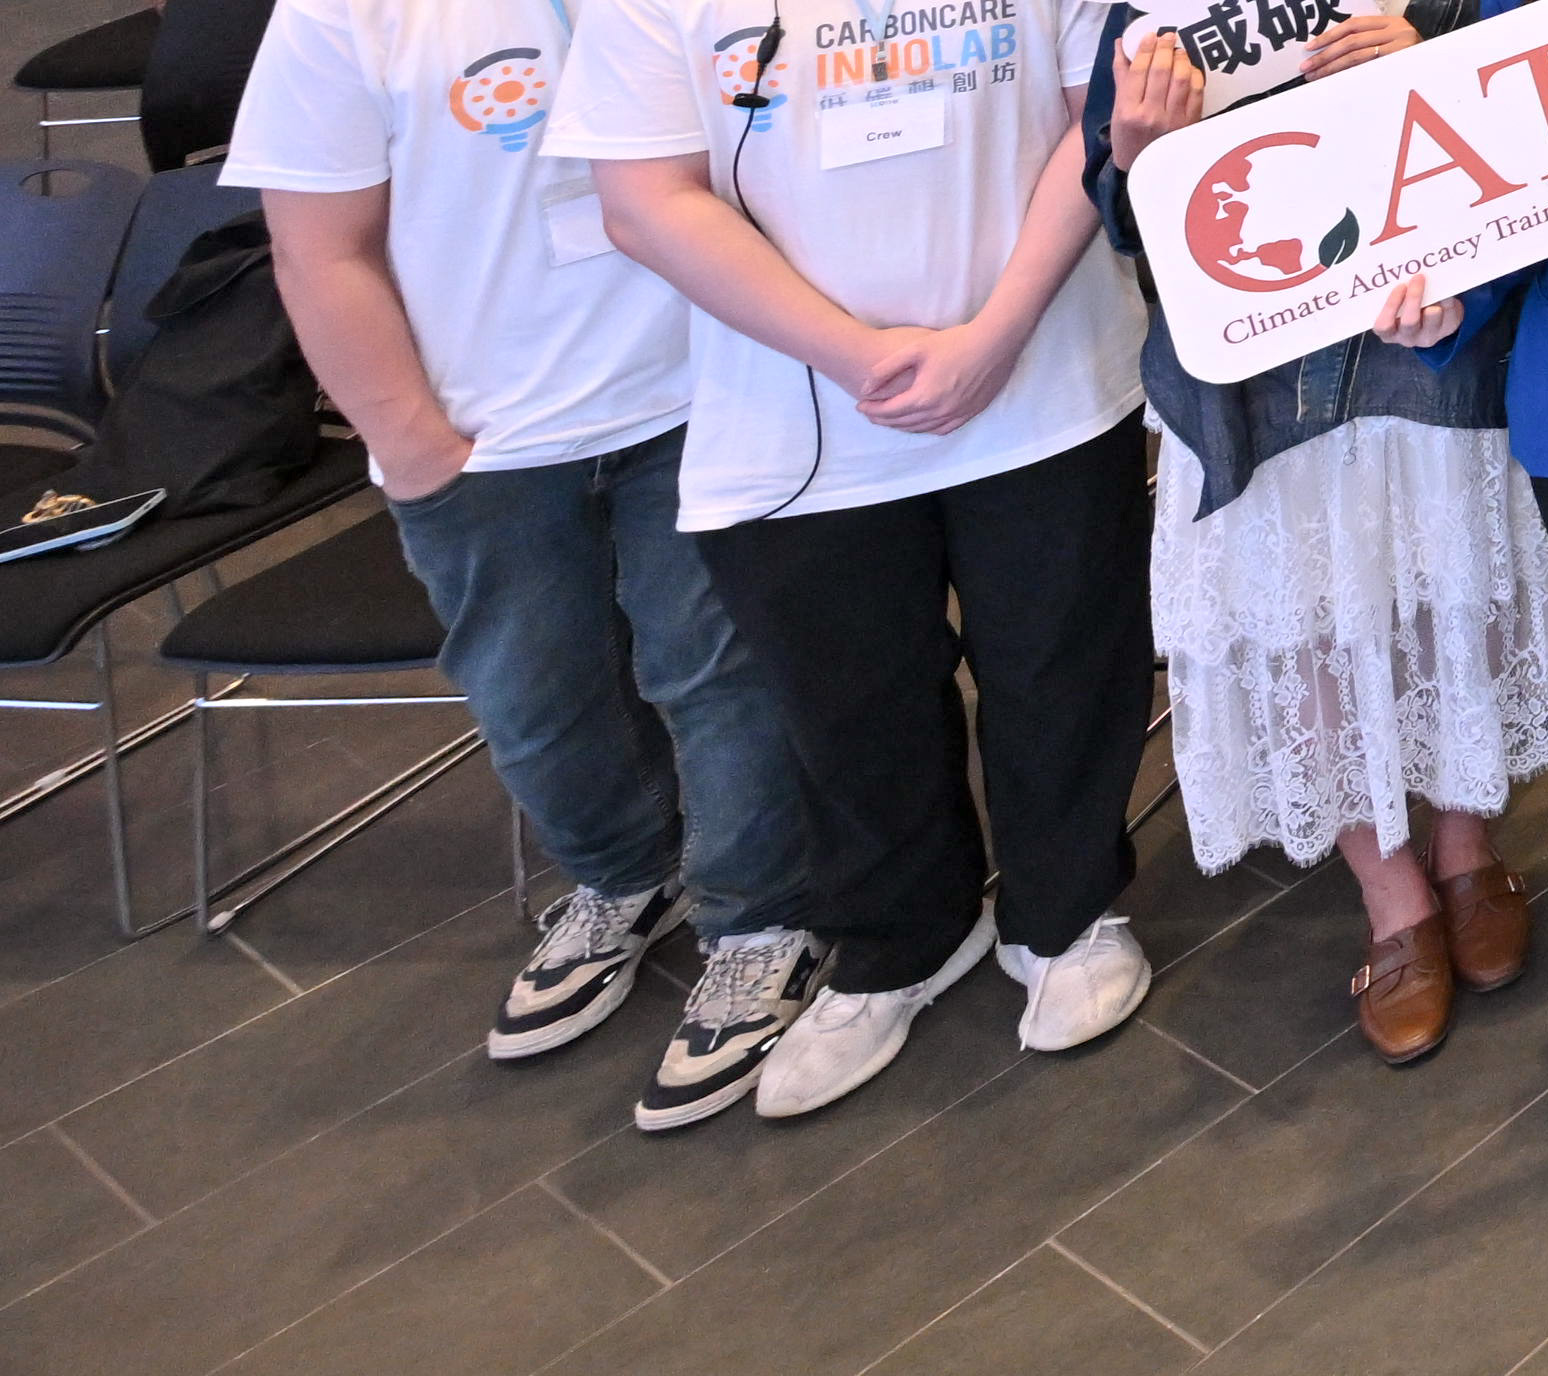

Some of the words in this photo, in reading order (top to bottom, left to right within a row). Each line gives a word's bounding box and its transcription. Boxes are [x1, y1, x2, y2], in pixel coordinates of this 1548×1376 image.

[866, 129, 903, 142] Crew
[1222, 288, 1341, 346] Climate
[1349, 233, 1483, 301] Advocacy
